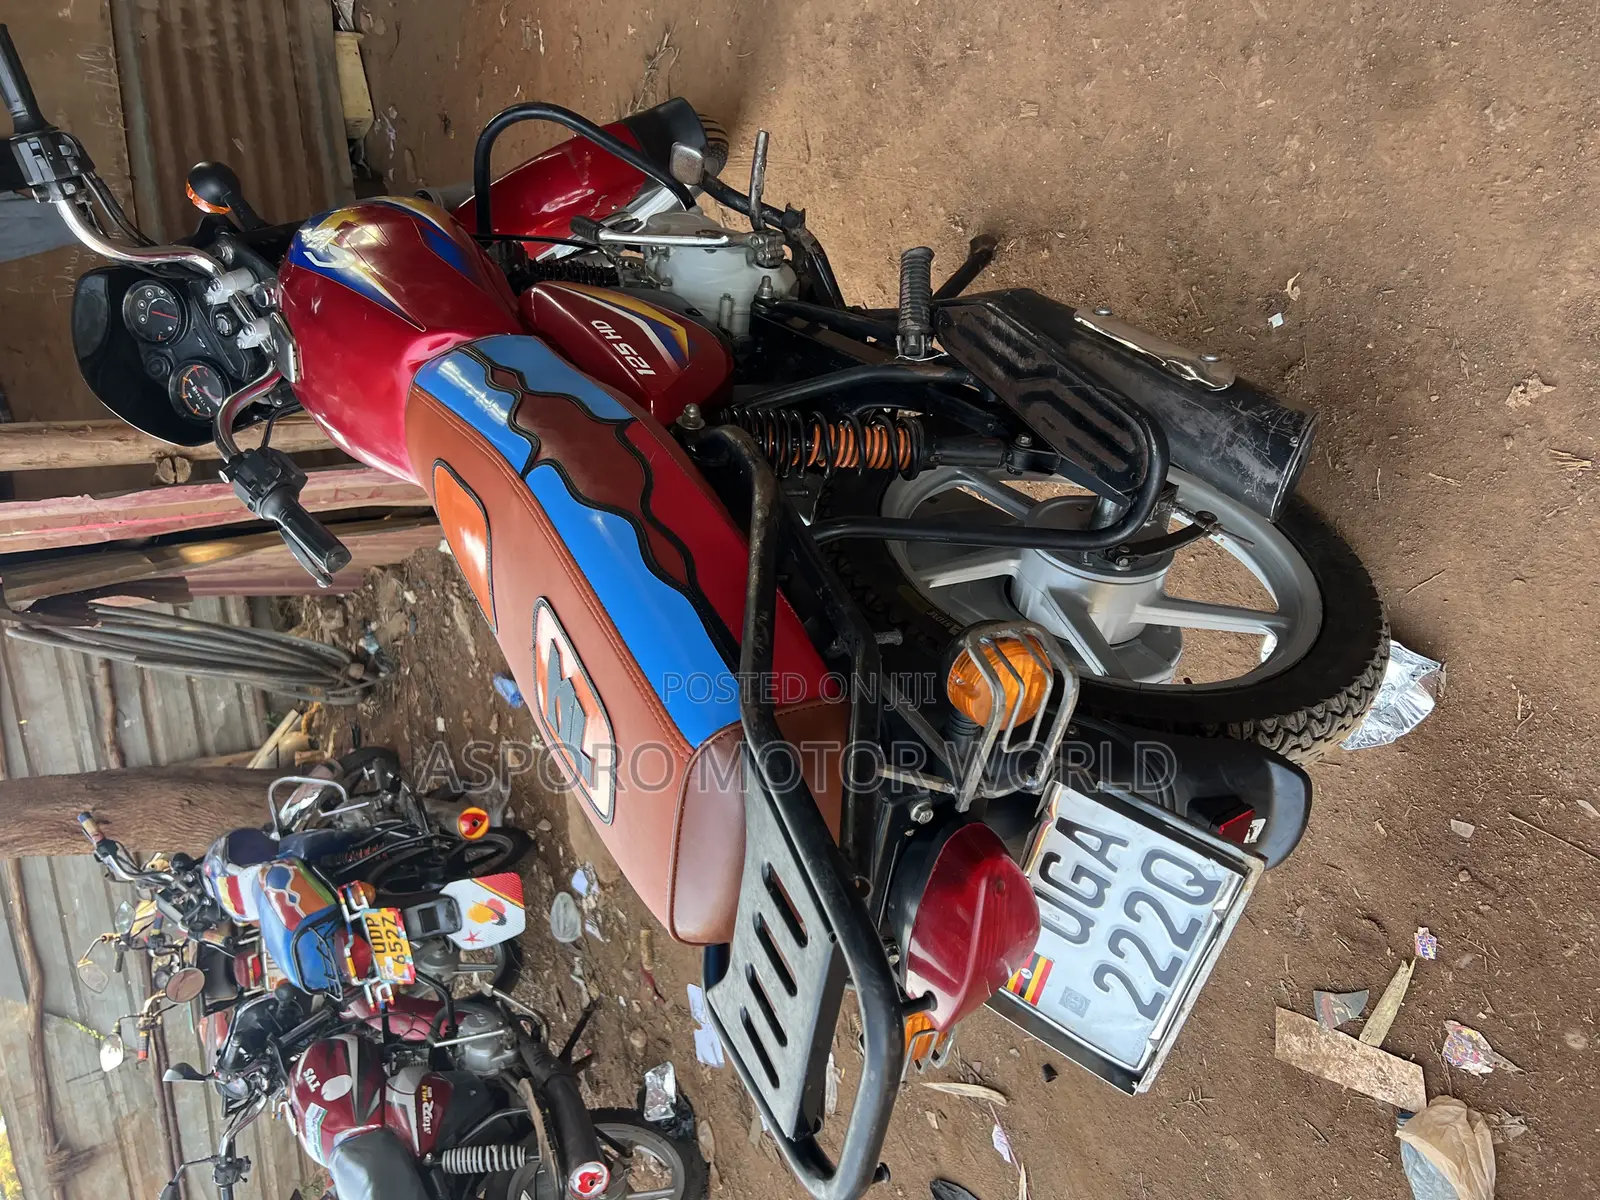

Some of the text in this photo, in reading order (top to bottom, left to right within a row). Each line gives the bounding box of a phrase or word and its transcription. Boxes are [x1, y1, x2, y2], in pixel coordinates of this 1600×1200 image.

[591, 319, 656, 375] 125 HD
[1033, 816, 1129, 945] UGA
[365, 917, 386, 954] UDP
[381, 915, 405, 964] 652Z
[1093, 849, 1222, 1021] 222Q
[302, 1066, 321, 1093] TVS
